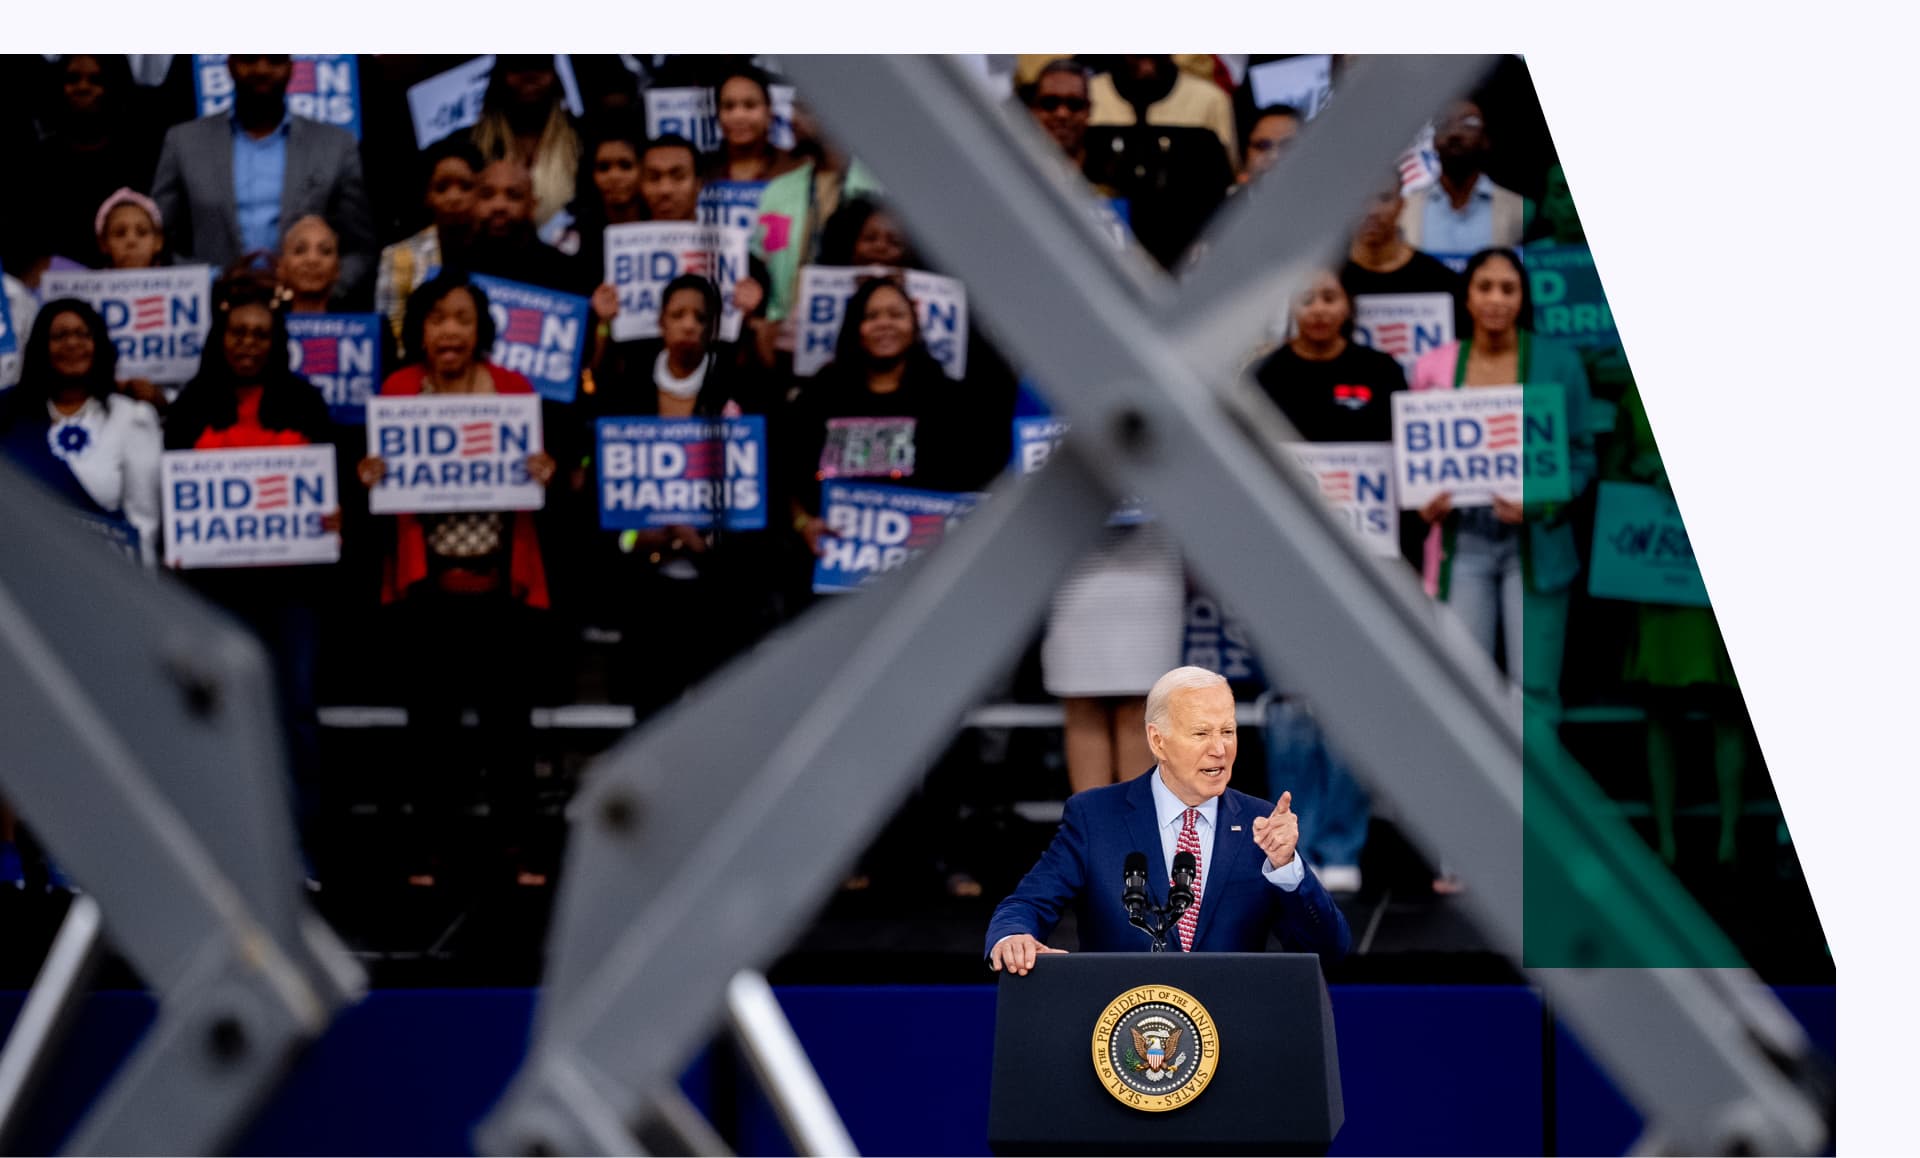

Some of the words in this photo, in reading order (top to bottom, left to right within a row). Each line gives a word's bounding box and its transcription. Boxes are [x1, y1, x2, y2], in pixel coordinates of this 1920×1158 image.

[201, 61, 350, 96] BEN
[615, 252, 738, 285] BIDEN
[101, 294, 199, 331] DEN
[112, 332, 203, 361] RRIS
[1357, 322, 1442, 354] DEN
[379, 421, 530, 458] BIDEN
[1405, 412, 1554, 453] BIDEN
[380, 458, 532, 488] HARRIS
[602, 440, 759, 480] BIDEN
[1407, 451, 1559, 484] HARRIS
[173, 474, 325, 512] BIDEN
[603, 479, 760, 511] HARRIS
[175, 512, 326, 545] HARRIS
[827, 504, 960, 548] BIDE
[1158, 991, 1171, 1001] OF
[1172, 994, 1188, 1008] THE
[1097, 989, 1156, 1043] PRESIDENT
[1190, 1006, 1215, 1059] UNITED
[1098, 1047, 1106, 1066] THE
[1102, 1067, 1112, 1079] OF
[1111, 1080, 1142, 1105] SEAL
[1164, 1069, 1209, 1107] STATES
